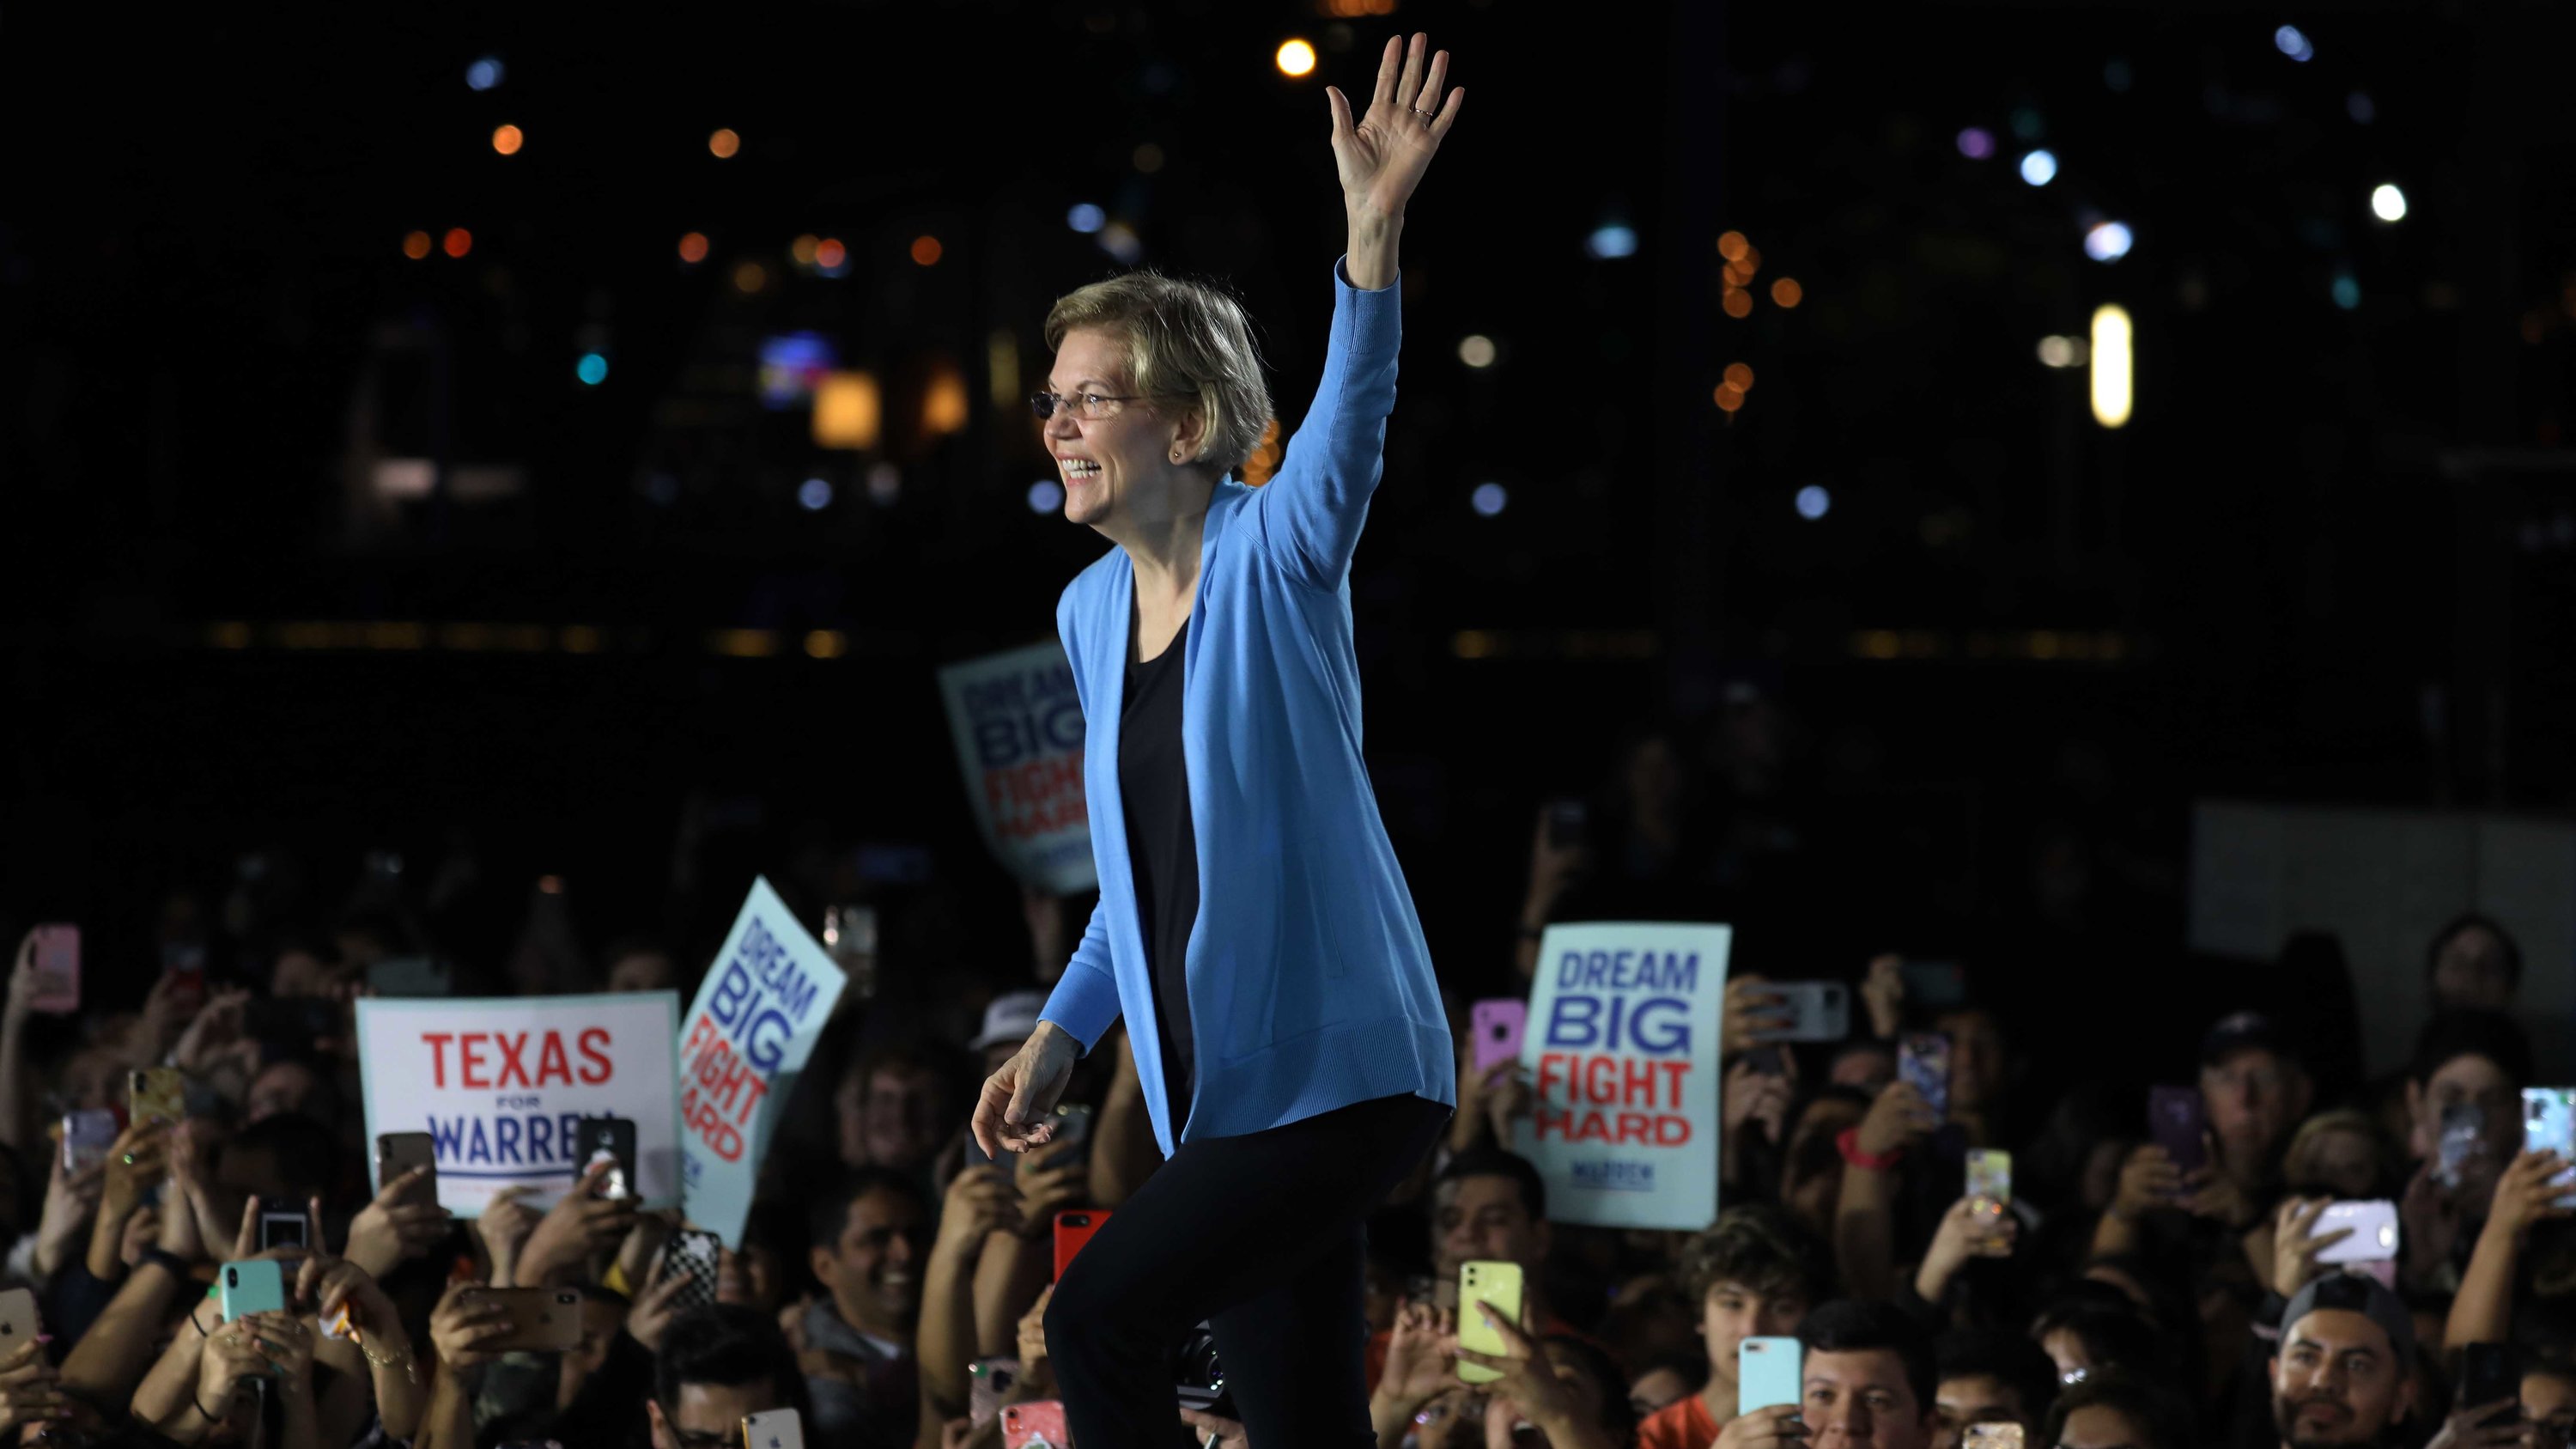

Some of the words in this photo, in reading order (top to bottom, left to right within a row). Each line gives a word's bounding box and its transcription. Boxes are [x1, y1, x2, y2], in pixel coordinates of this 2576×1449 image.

[975, 698, 1086, 769] BIG
[984, 747, 1085, 810] FIGH
[994, 797, 1089, 839] HAR
[738, 915, 817, 1024] DREAM
[1557, 950, 1700, 993] DREAM
[708, 959, 793, 1075] BIG
[1546, 995, 1693, 1056] BIG
[421, 1026, 614, 1089] TEXAS
[681, 1012, 769, 1126] FIGHT
[1537, 1053, 1692, 1110] FIGHT
[495, 1094, 541, 1111] FOR
[681, 1075, 744, 1163] ARD
[1534, 1109, 1692, 1148] HARD
[427, 1109, 614, 1163] WARRE
